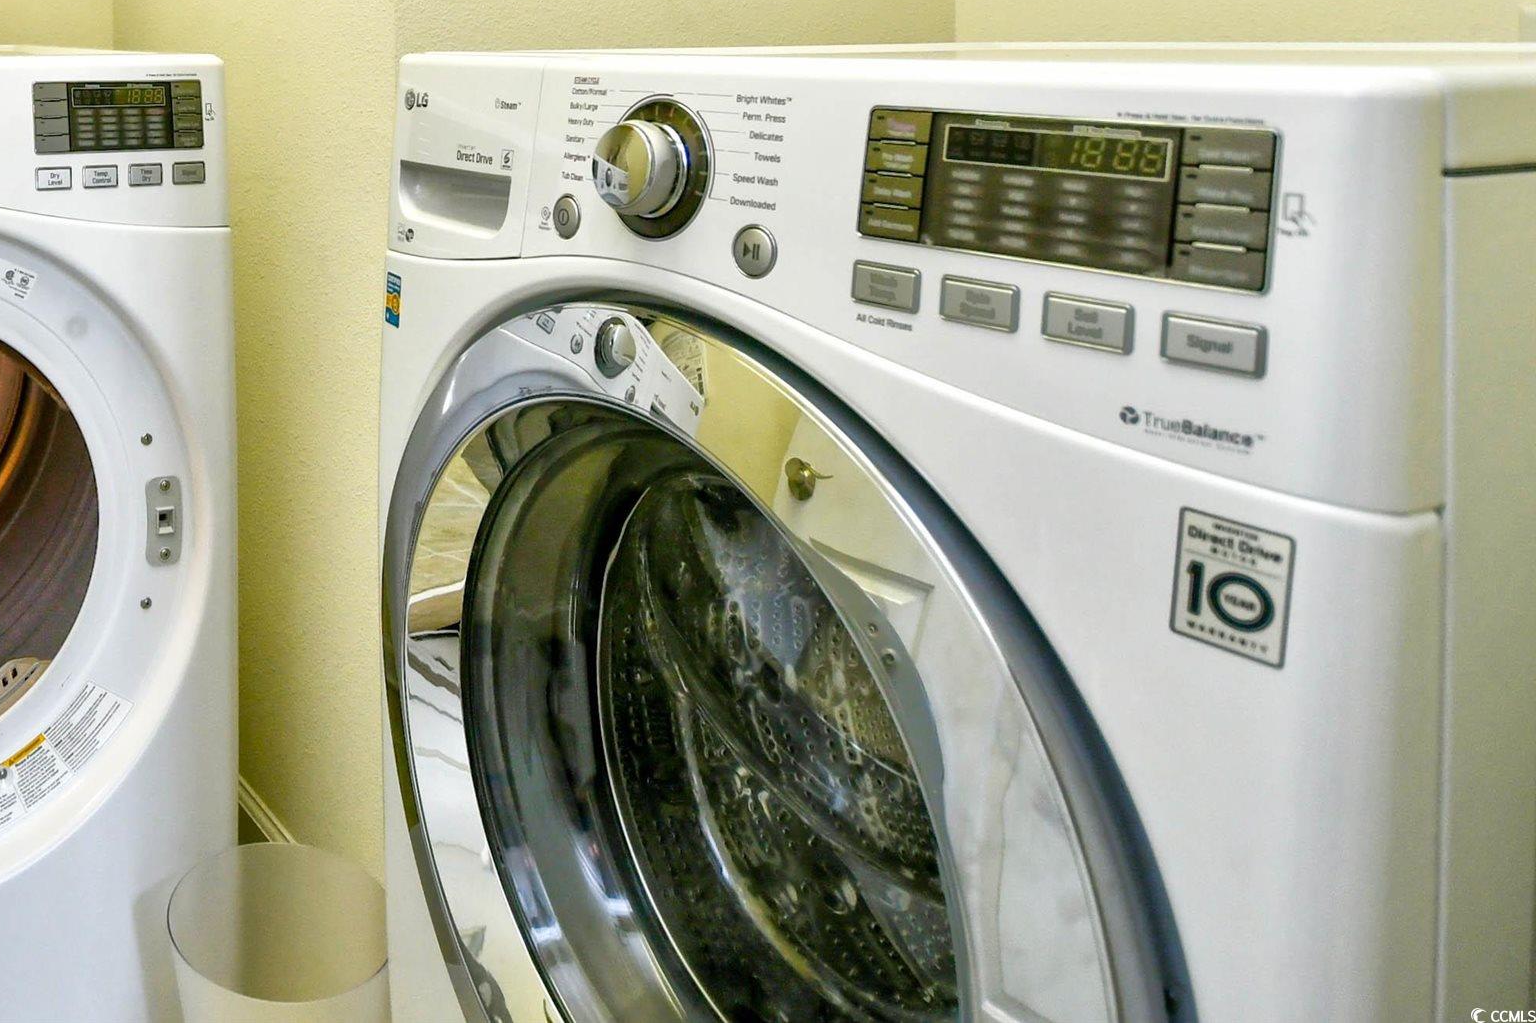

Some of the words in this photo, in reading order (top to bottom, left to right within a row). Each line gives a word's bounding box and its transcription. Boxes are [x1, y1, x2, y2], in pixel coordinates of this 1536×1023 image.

[572, 88, 607, 96] Cotton/Normal
[416, 92, 429, 108] LG
[736, 93, 757, 106] Bright
[570, 101, 598, 112] Bulky/Large
[568, 118, 582, 126] Heavy
[742, 113, 766, 123] Perm.
[766, 114, 786, 124] Press
[566, 135, 585, 144] Sanitary
[749, 130, 784, 143] Delicates
[456, 150, 476, 162] Direct
[476, 152, 493, 166] Drive
[754, 152, 781, 164] Towels
[571, 172, 584, 181] Clean
[732, 174, 756, 186] Speed
[758, 176, 778, 187] Wash
[730, 196, 776, 211] Downloaded
[856, 313, 866, 324] All
[867, 315, 885, 327] Cold
[886, 319, 913, 332] Rinses
[1186, 334, 1234, 356] Signal
[1188, 526, 1234, 550] Direct
[1238, 540, 1283, 563] Drive
[1187, 560, 1275, 633] 10
